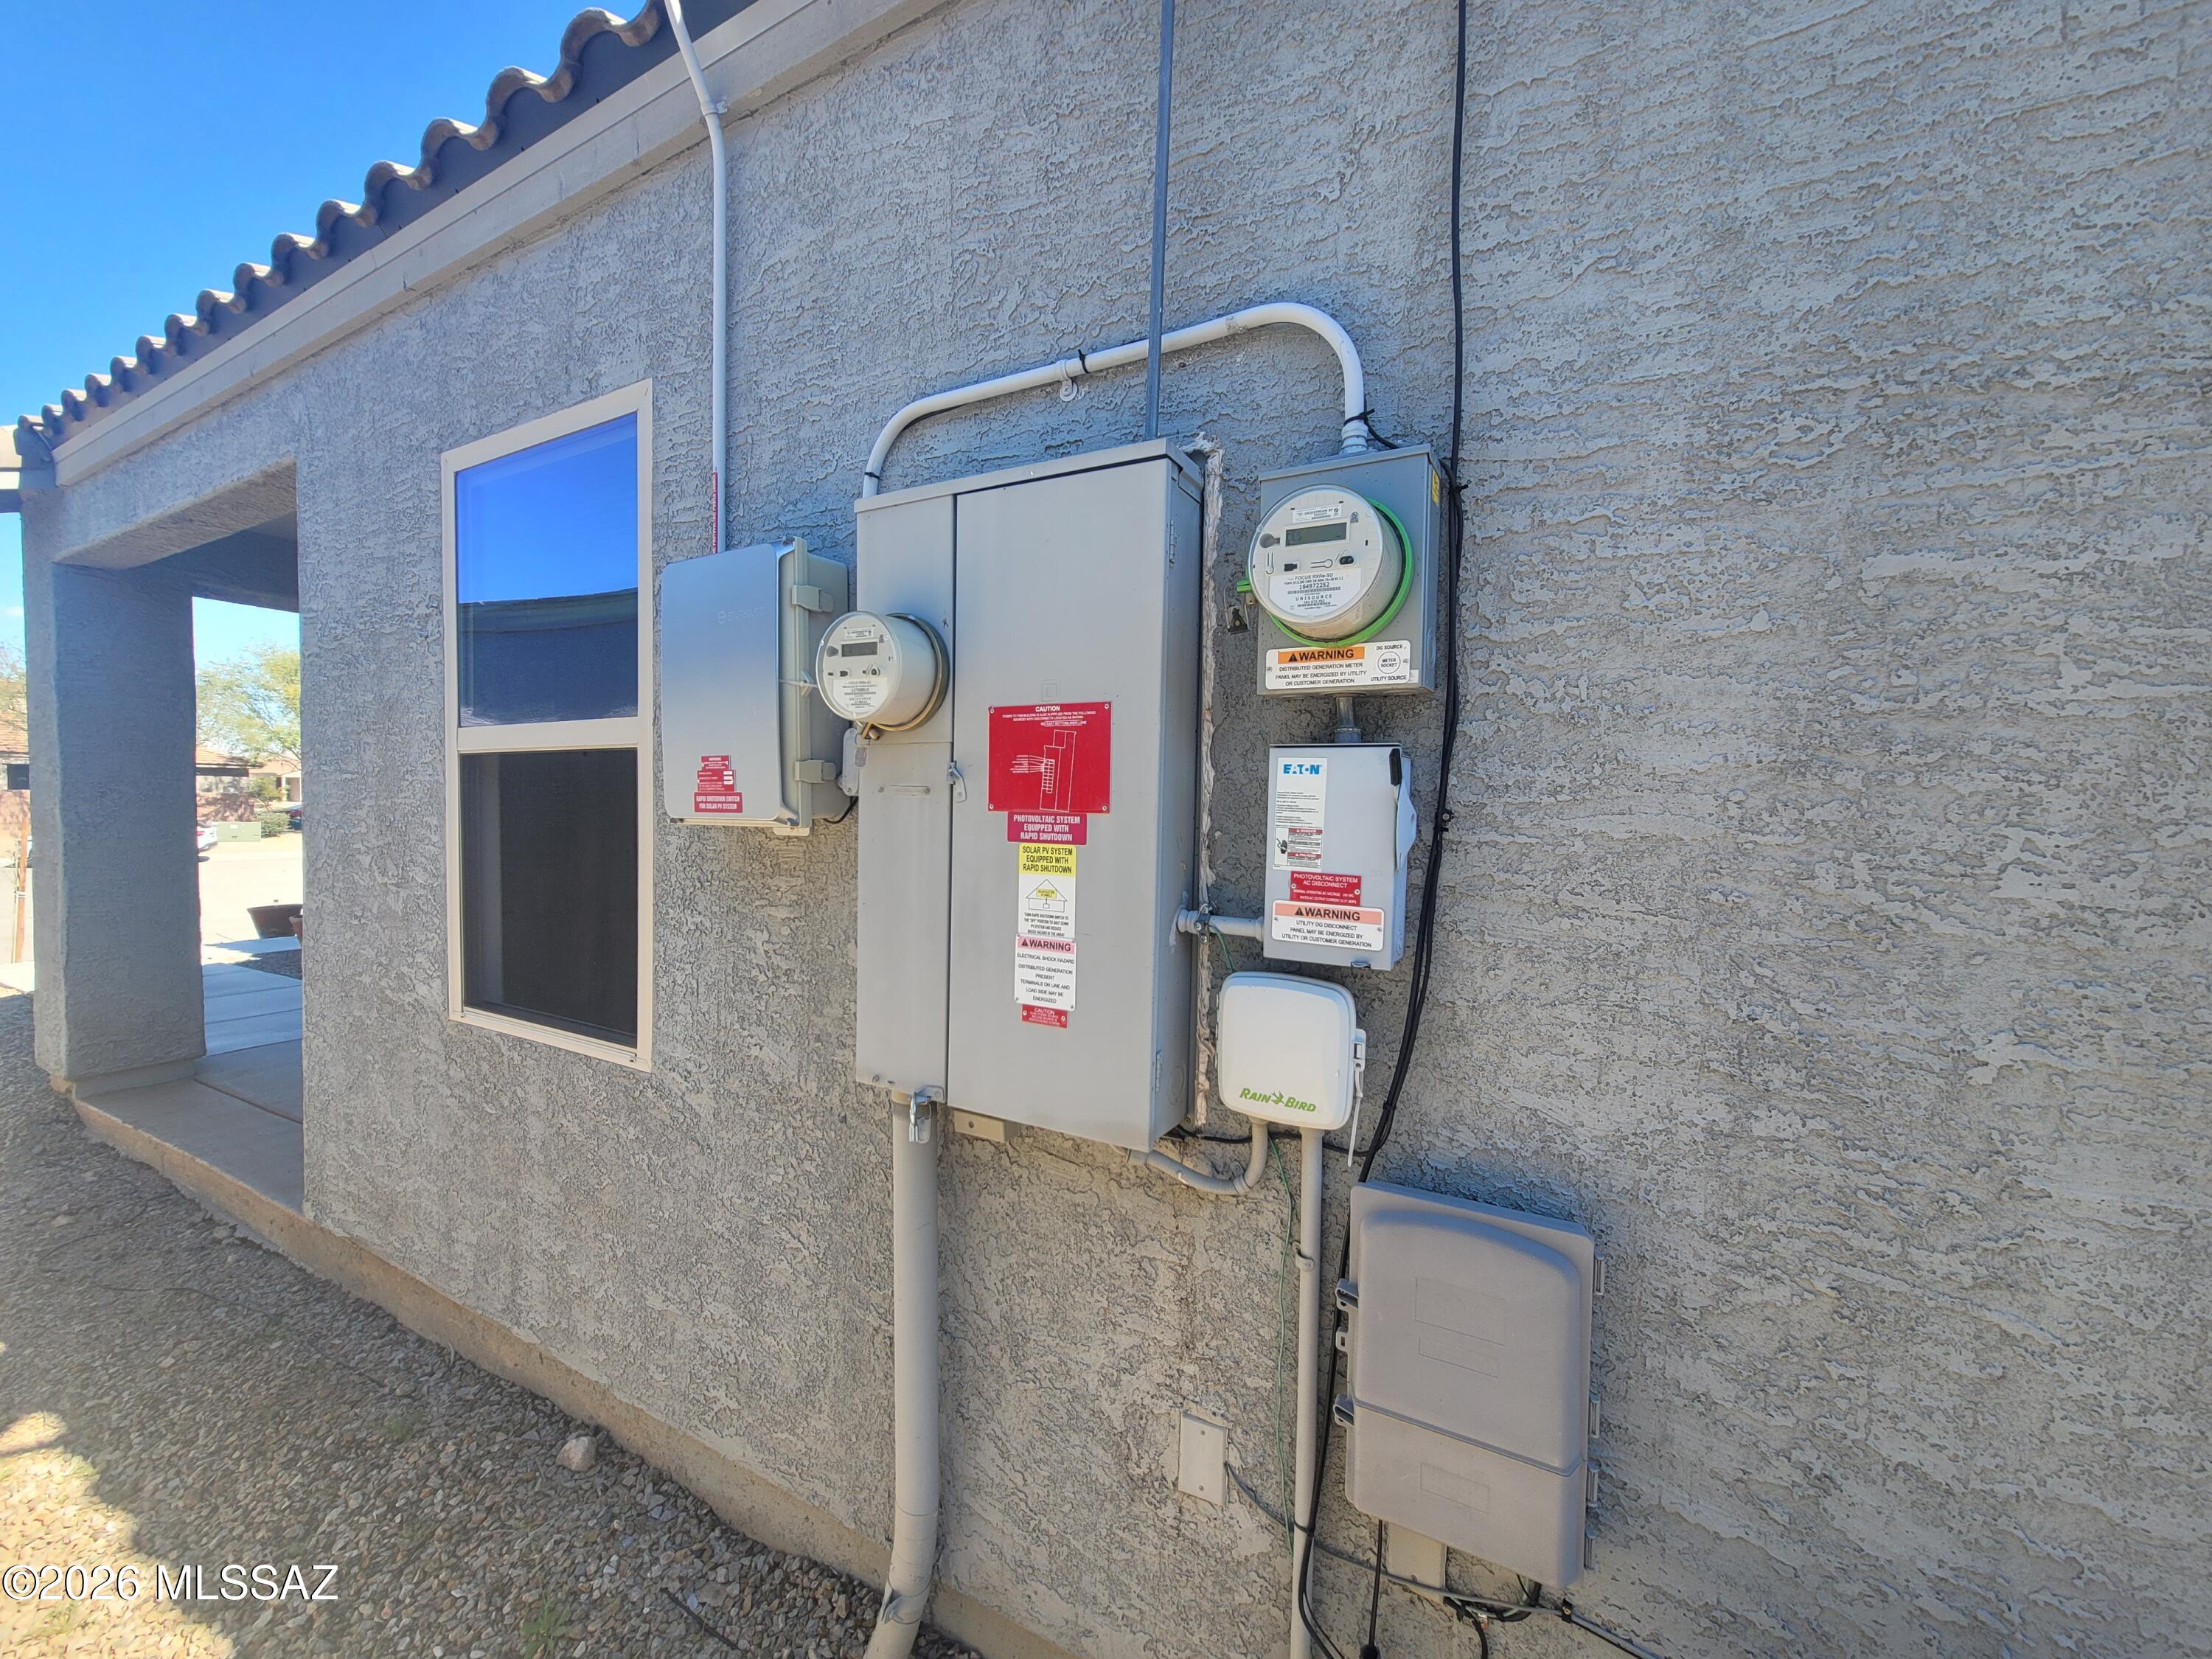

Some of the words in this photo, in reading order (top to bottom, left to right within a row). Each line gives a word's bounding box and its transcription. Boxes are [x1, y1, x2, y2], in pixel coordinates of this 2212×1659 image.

[1299, 650, 1354, 661] WARNING
[1014, 815, 1054, 823] PHOTOVOLTAIC
[1051, 847, 1072, 855] SYSTEM
[1026, 855, 1053, 863] EQUIPPED
[1040, 865, 1071, 873] SHUTDOWN
[1305, 908, 1360, 920] WARNING
[1029, 939, 1071, 951] WARNING
[1046, 967, 1073, 975] GENERATION
[1239, 1088, 1271, 1103] RAIN
[1284, 1097, 1317, 1112] BIRD
